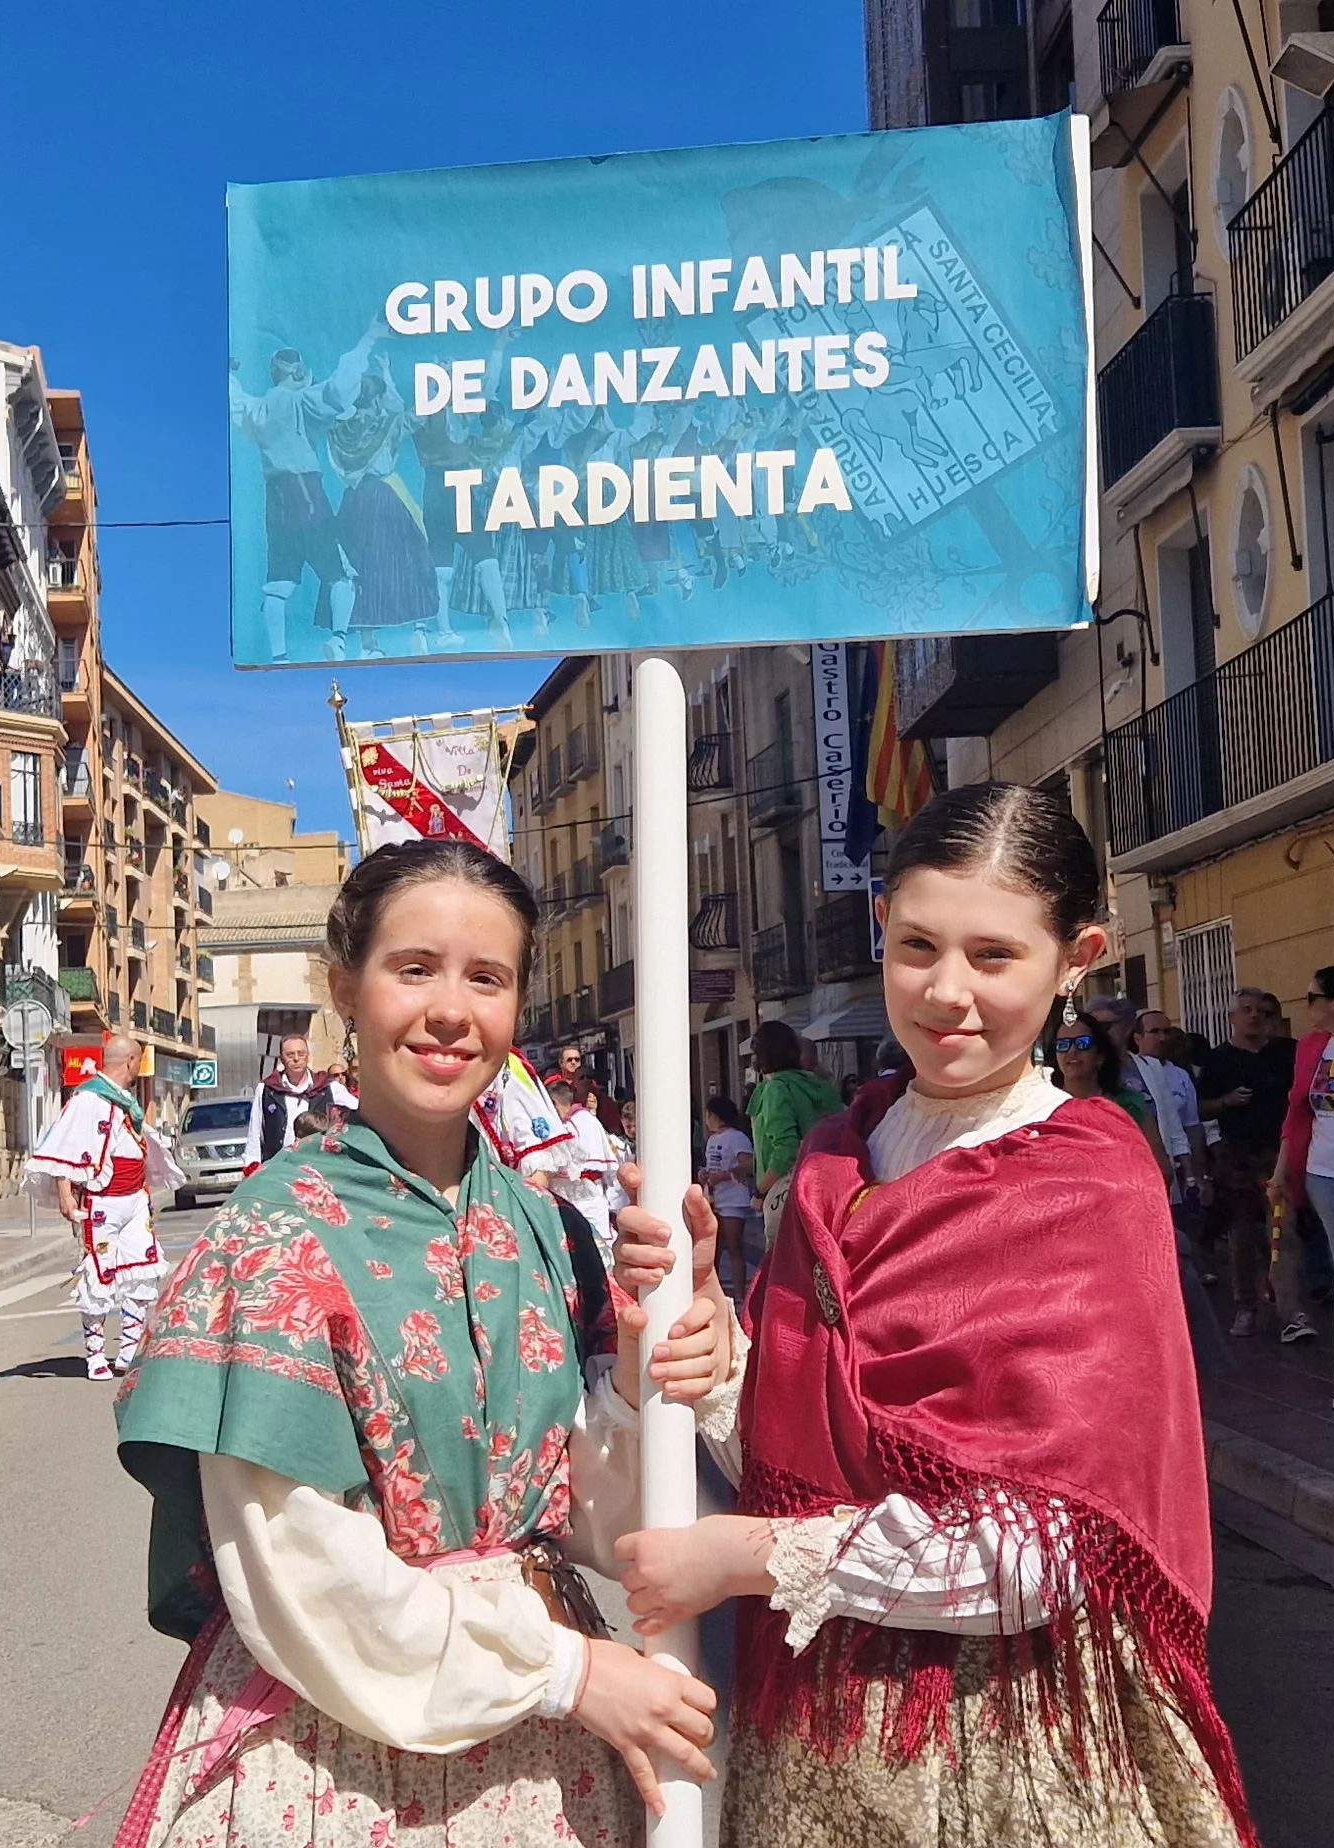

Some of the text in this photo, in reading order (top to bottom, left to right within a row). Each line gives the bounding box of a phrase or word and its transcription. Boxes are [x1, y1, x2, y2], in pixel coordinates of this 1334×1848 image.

[385, 245, 918, 335] GRUPO INFANTIL
[929, 238, 1055, 421] SANTA CECILIA
[414, 332, 890, 416] DE DANZANTES
[444, 448, 853, 533] TARDIENTA
[907, 430, 1023, 510] HUESCA
